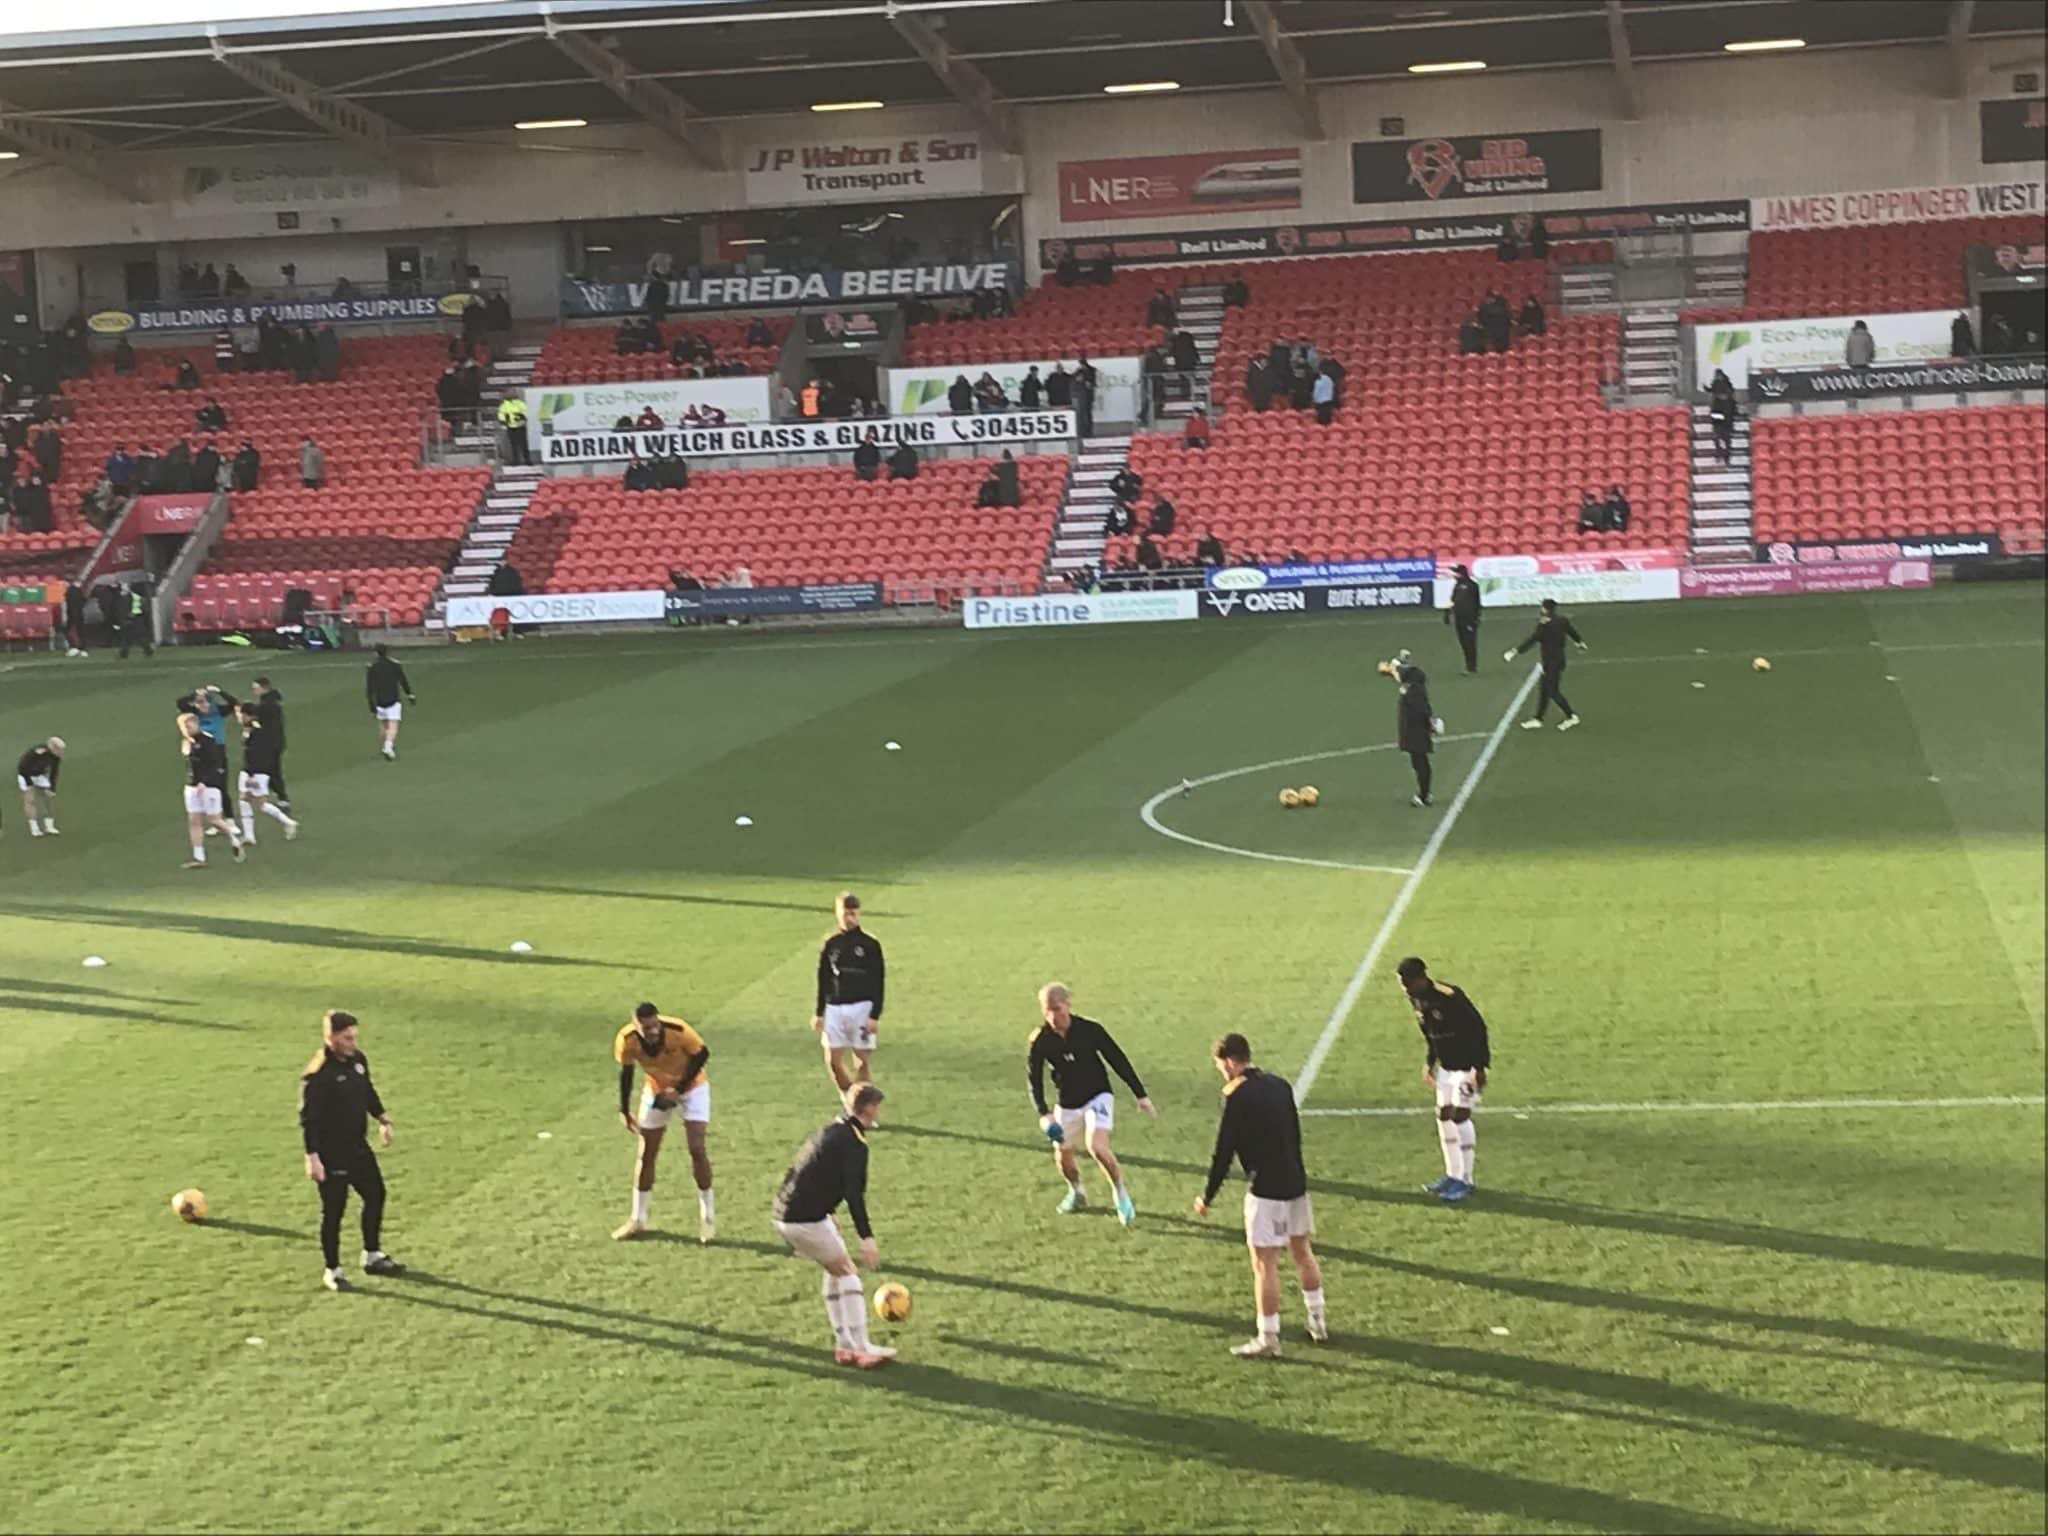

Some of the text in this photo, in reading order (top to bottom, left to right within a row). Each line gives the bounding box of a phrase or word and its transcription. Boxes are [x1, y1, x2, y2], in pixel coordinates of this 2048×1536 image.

[748, 139, 978, 173] J P Walton & Son
[802, 168, 925, 192] Transport
[1070, 176, 1151, 205] LNER
[1762, 182, 2041, 227] JAMES COPPINGER WEST
[841, 263, 1008, 297] BEEHIVE
[139, 308, 228, 329] BUILDING
[231, 308, 246, 324] &
[250, 301, 349, 323] PUMBING
[353, 297, 437, 319] SUPPLIES
[550, 414, 1069, 459] ADRIAN WELCH GLASS & GLAZING 304555
[974, 599, 1091, 625] Pristine
